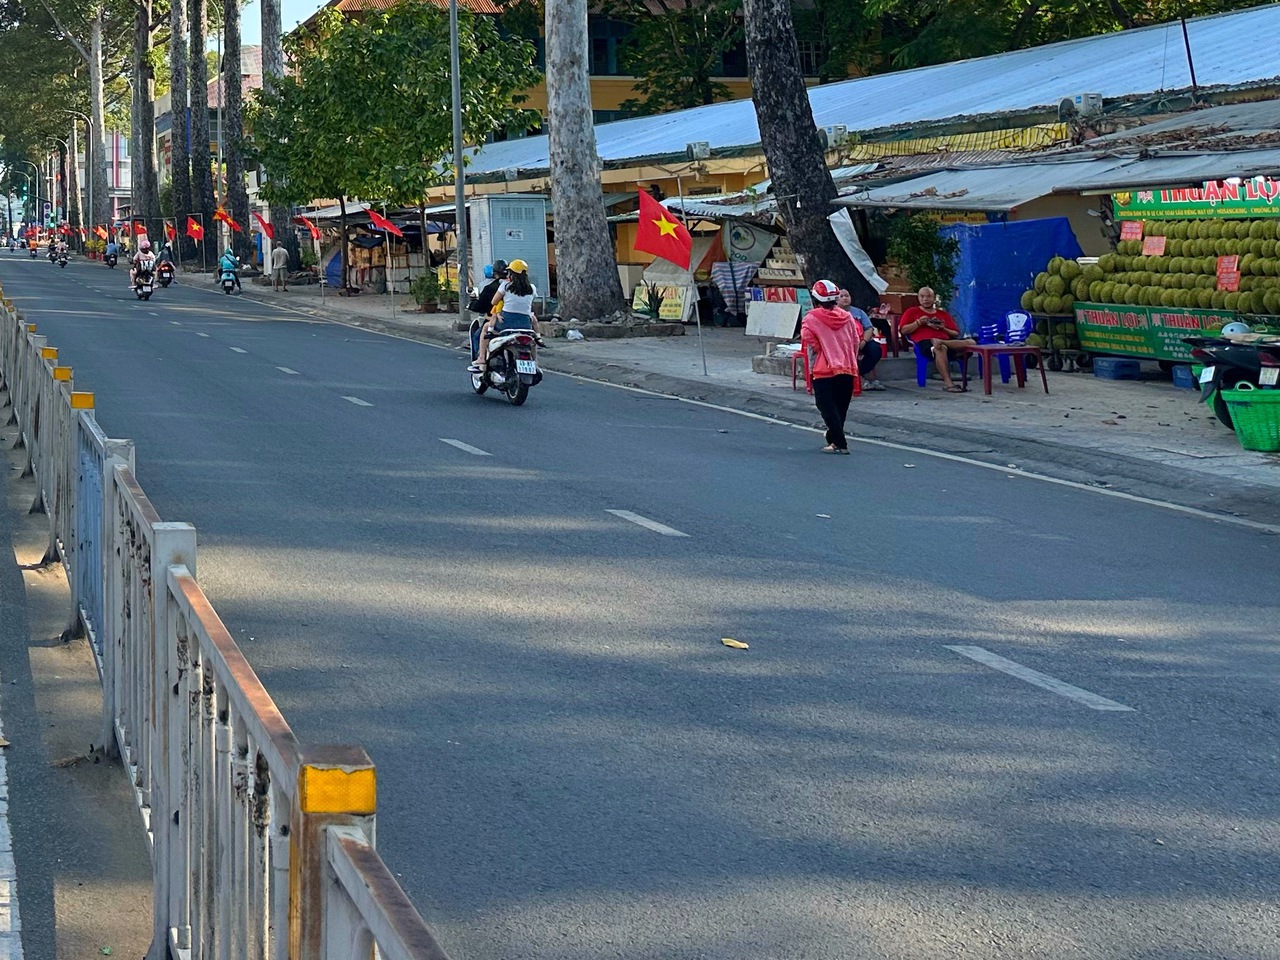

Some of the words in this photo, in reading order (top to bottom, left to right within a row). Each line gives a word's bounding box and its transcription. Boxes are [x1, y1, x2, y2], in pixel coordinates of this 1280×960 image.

[1245, 177, 1280, 204] LỢ
[1085, 308, 1121, 330] THUẬN
[1162, 311, 1202, 332] THUẬN
